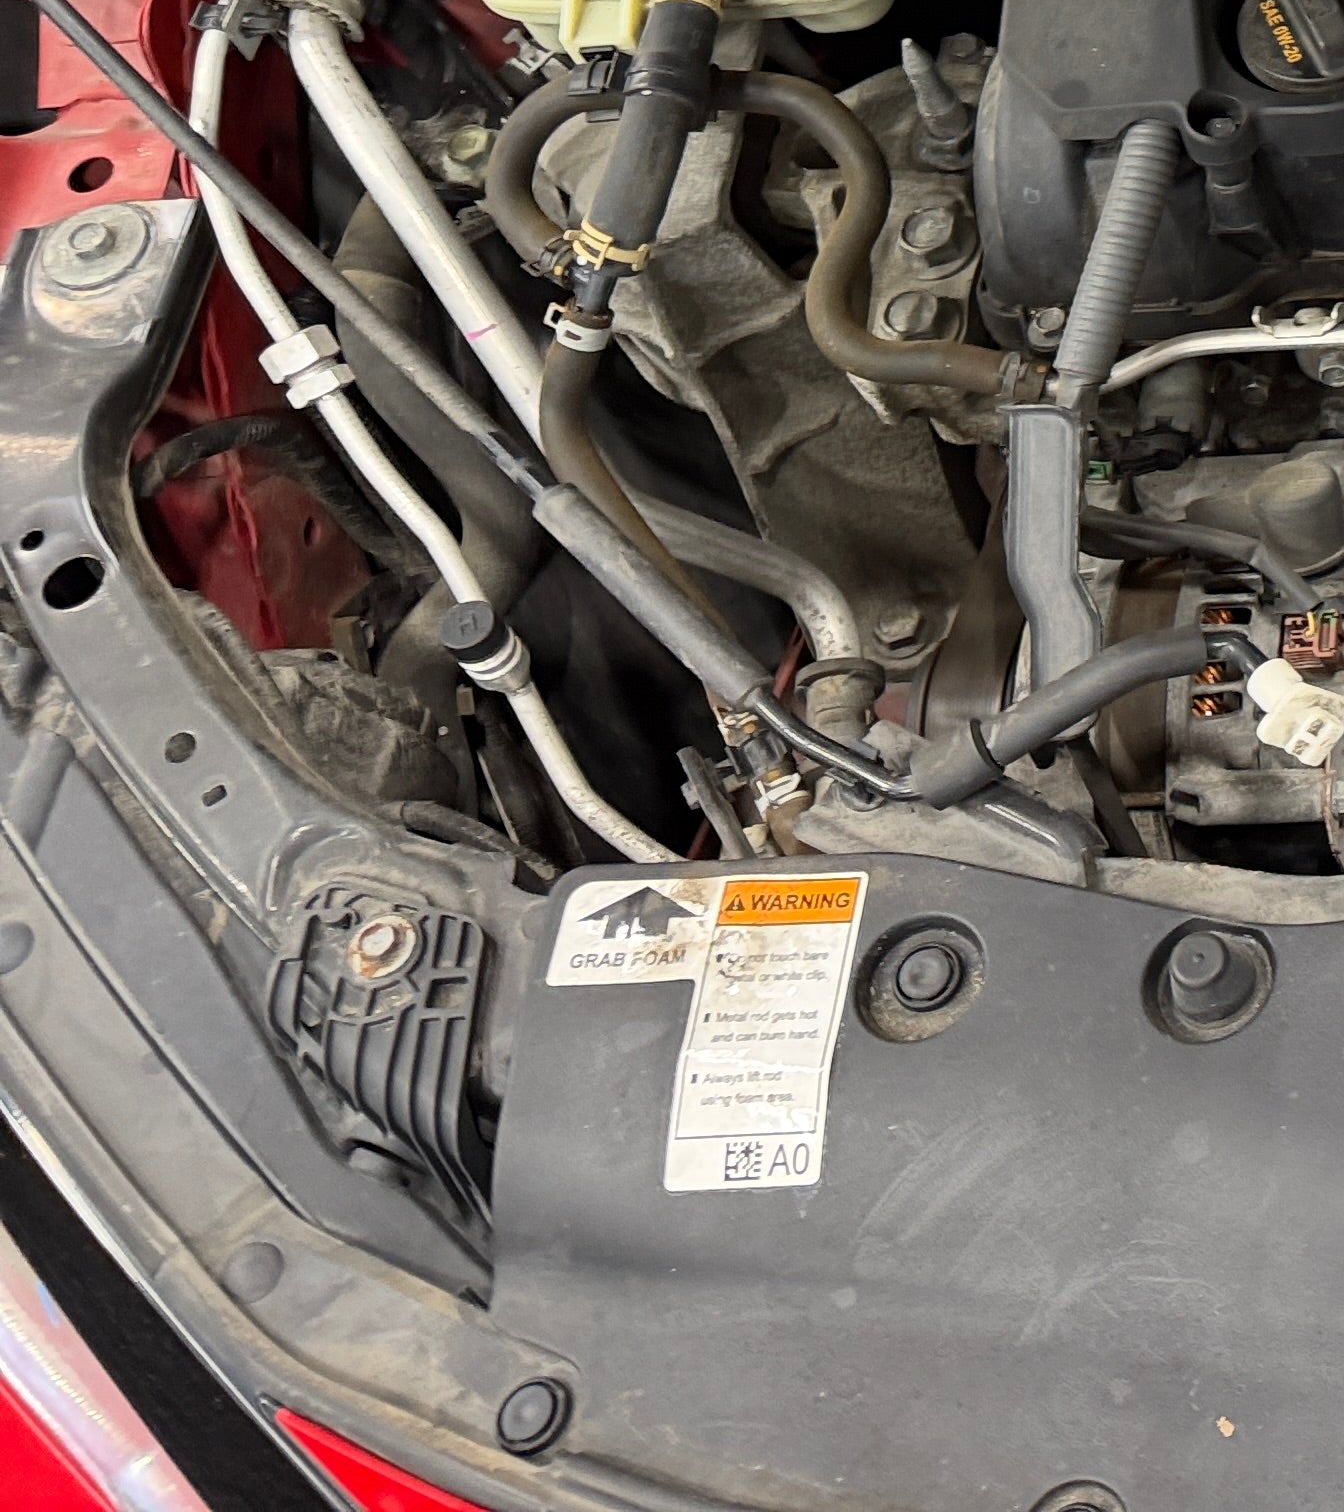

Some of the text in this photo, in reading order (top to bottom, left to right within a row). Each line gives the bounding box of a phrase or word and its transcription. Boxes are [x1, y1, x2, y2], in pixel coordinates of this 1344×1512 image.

[1259, 0, 1303, 64] SAE 0W-20
[751, 892, 851, 911] WARNING
[569, 949, 687, 969] GRAB FOAM
